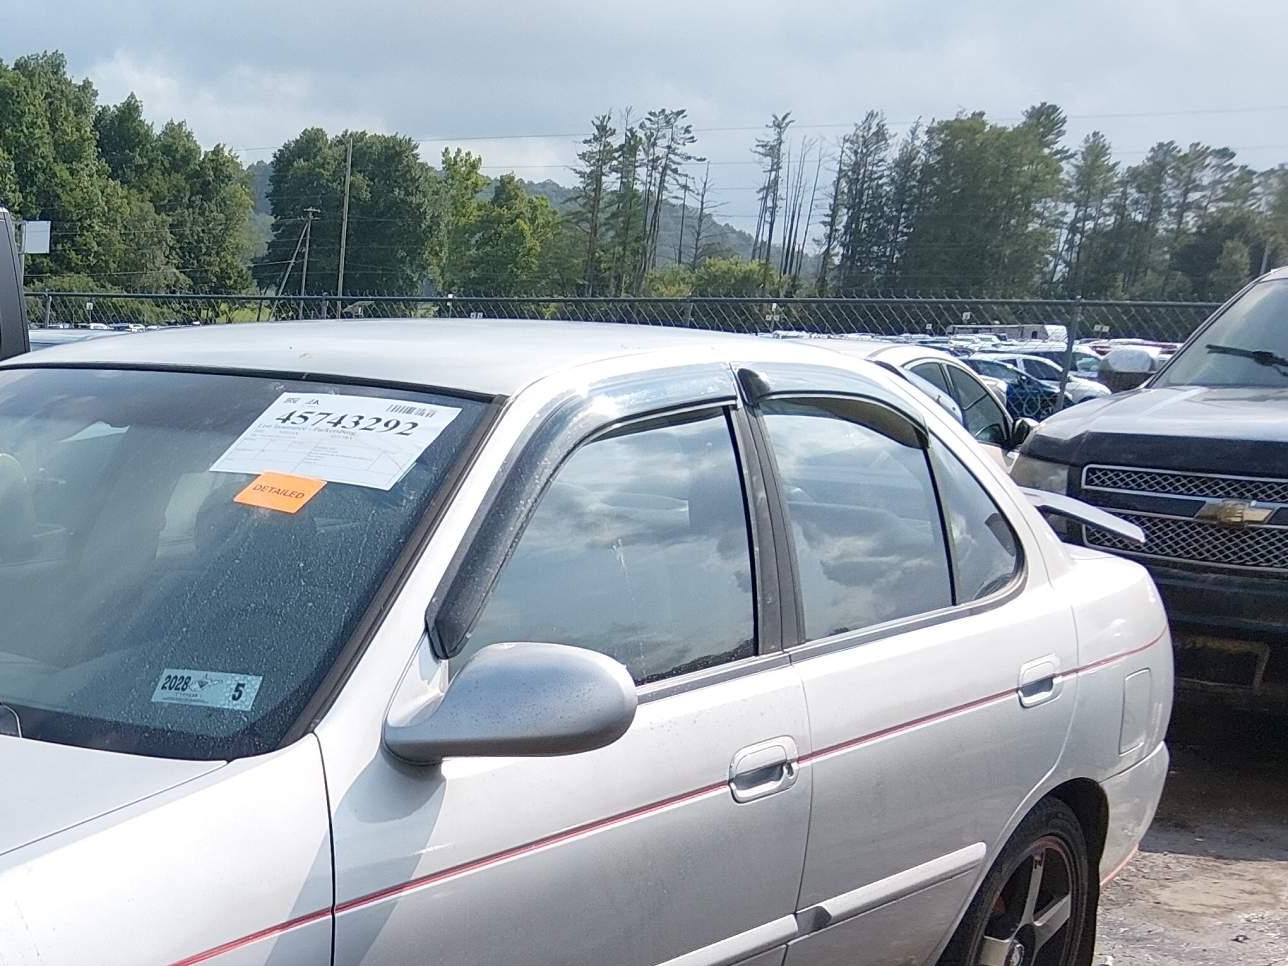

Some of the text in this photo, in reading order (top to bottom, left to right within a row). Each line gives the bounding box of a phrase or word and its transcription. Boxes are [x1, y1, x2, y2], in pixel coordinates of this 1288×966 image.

[275, 410, 420, 437] 45743292
[252, 484, 305, 499] DETAILED
[161, 674, 246, 702] 2028 5
